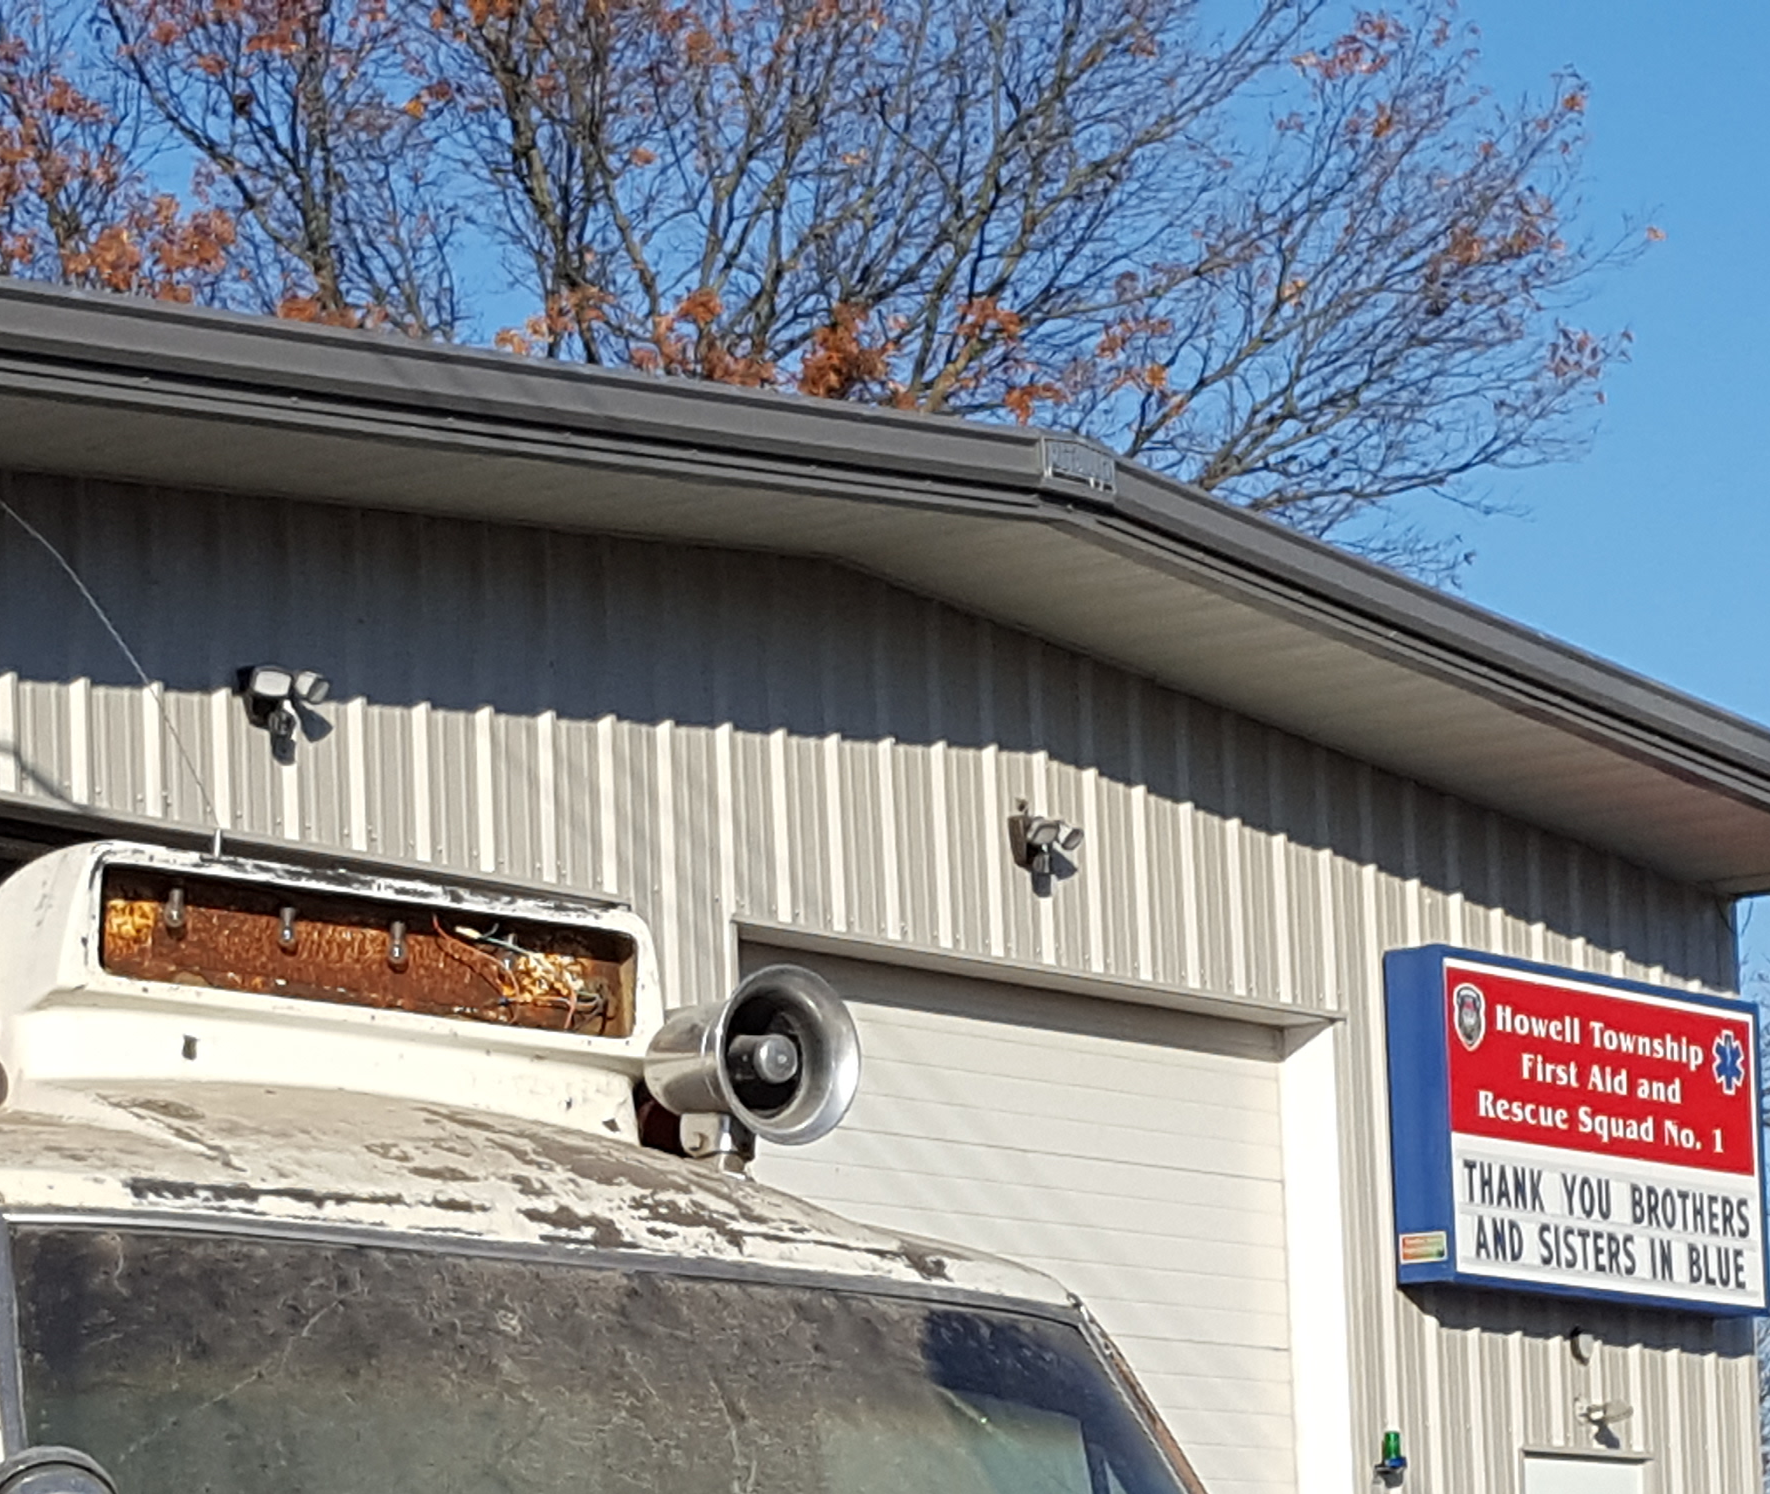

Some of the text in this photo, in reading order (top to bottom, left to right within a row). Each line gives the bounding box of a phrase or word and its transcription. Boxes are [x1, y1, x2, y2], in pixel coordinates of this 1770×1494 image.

[1496, 1004, 1704, 1072] Howell Township
[1521, 1053, 1682, 1104] First Aid and
[1478, 1090, 1724, 1154] Rescue Squad No. 1
[1463, 1159, 1750, 1239] THANK YOU BROTHERS
[1475, 1215, 1524, 1262] AND
[1538, 1223, 1636, 1276] SISTERS
[1650, 1237, 1674, 1281] IN
[1688, 1243, 1747, 1290] BLUE
